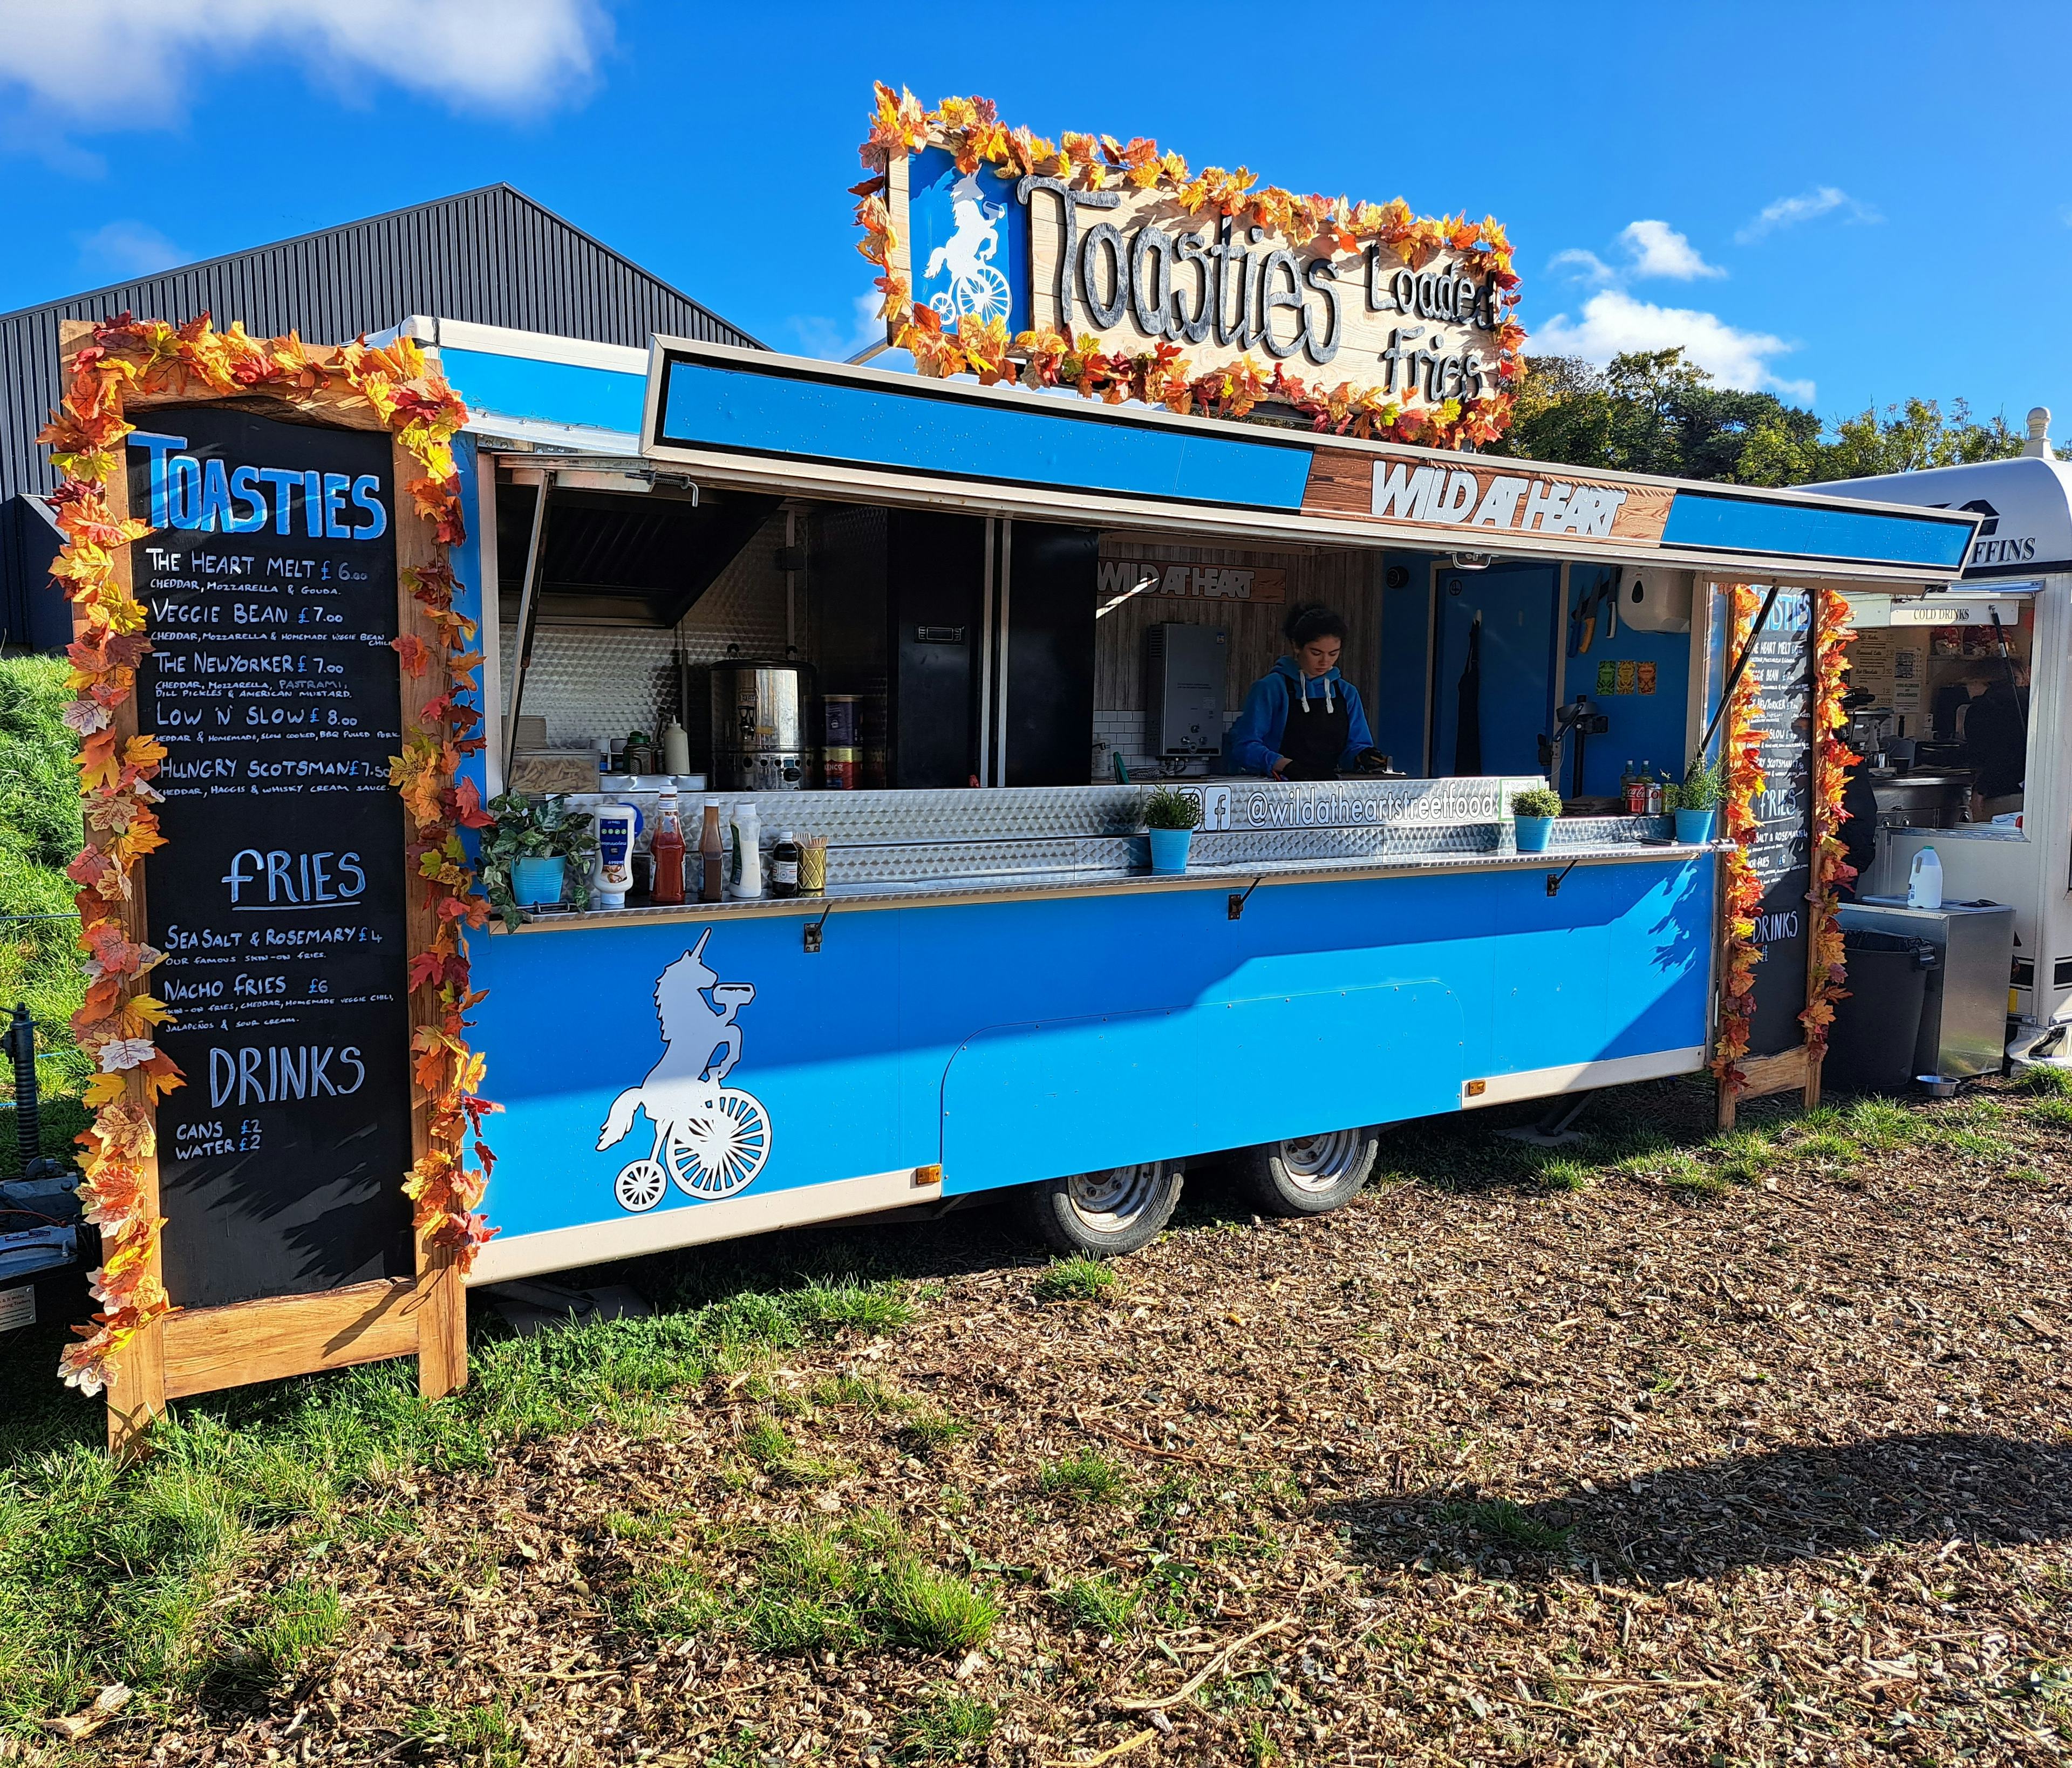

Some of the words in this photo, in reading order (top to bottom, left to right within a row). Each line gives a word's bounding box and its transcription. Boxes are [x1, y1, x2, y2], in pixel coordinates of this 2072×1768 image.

[1015, 174, 1342, 365] Toasties
[1371, 242, 1497, 331] Loaded
[127, 431, 387, 540] TOASTIES
[1371, 460, 1478, 523] WILD
[1471, 475, 1531, 528] AT
[1521, 480, 1628, 536] HEART
[145, 548, 181, 571] THE
[192, 550, 255, 575] HEART
[267, 557, 315, 578] MELT
[288, 584, 295, 595] &
[1160, 565, 1190, 595] AT
[1192, 567, 1255, 598] HEART
[152, 598, 220, 623] VEGGIE
[234, 603, 288, 624] BEAN
[1914, 609, 1936, 619] COLD
[1939, 608, 1969, 621] DRINKS
[270, 632, 277, 641] &
[1760, 641, 1776, 654] HEART
[1777, 641, 1791, 655] MELT
[152, 652, 186, 673] THE
[1766, 668, 1779, 681] BEAN
[155, 689, 178, 698] DILL
[228, 690, 234, 699] &
[238, 689, 292, 697] AMERICAN
[156, 701, 202, 726] LOW
[246, 706, 304, 725] SLOW
[196, 731, 204, 743] &
[161, 757, 237, 778] HUNGRY
[247, 760, 351, 778] SCOTSMAN
[1767, 758, 1792, 768] SCOTSMAN
[210, 785, 246, 794] HAGGIS
[250, 784, 259, 795] &
[262, 784, 303, 793] WHISKY
[310, 784, 350, 793] CREAM
[1246, 782, 1495, 827] @wildatheartstreetfood
[249, 931, 260, 947] &
[266, 926, 356, 945] ROSEMARY
[1753, 911, 1798, 943] DRINKS
[164, 955, 189, 966] OUR
[164, 979, 224, 1001] NACHO
[220, 1019, 228, 1031] &
[209, 1046, 365, 1108] DRINKS
[176, 1121, 224, 1142] CANS
[175, 1137, 235, 1160] WATER
